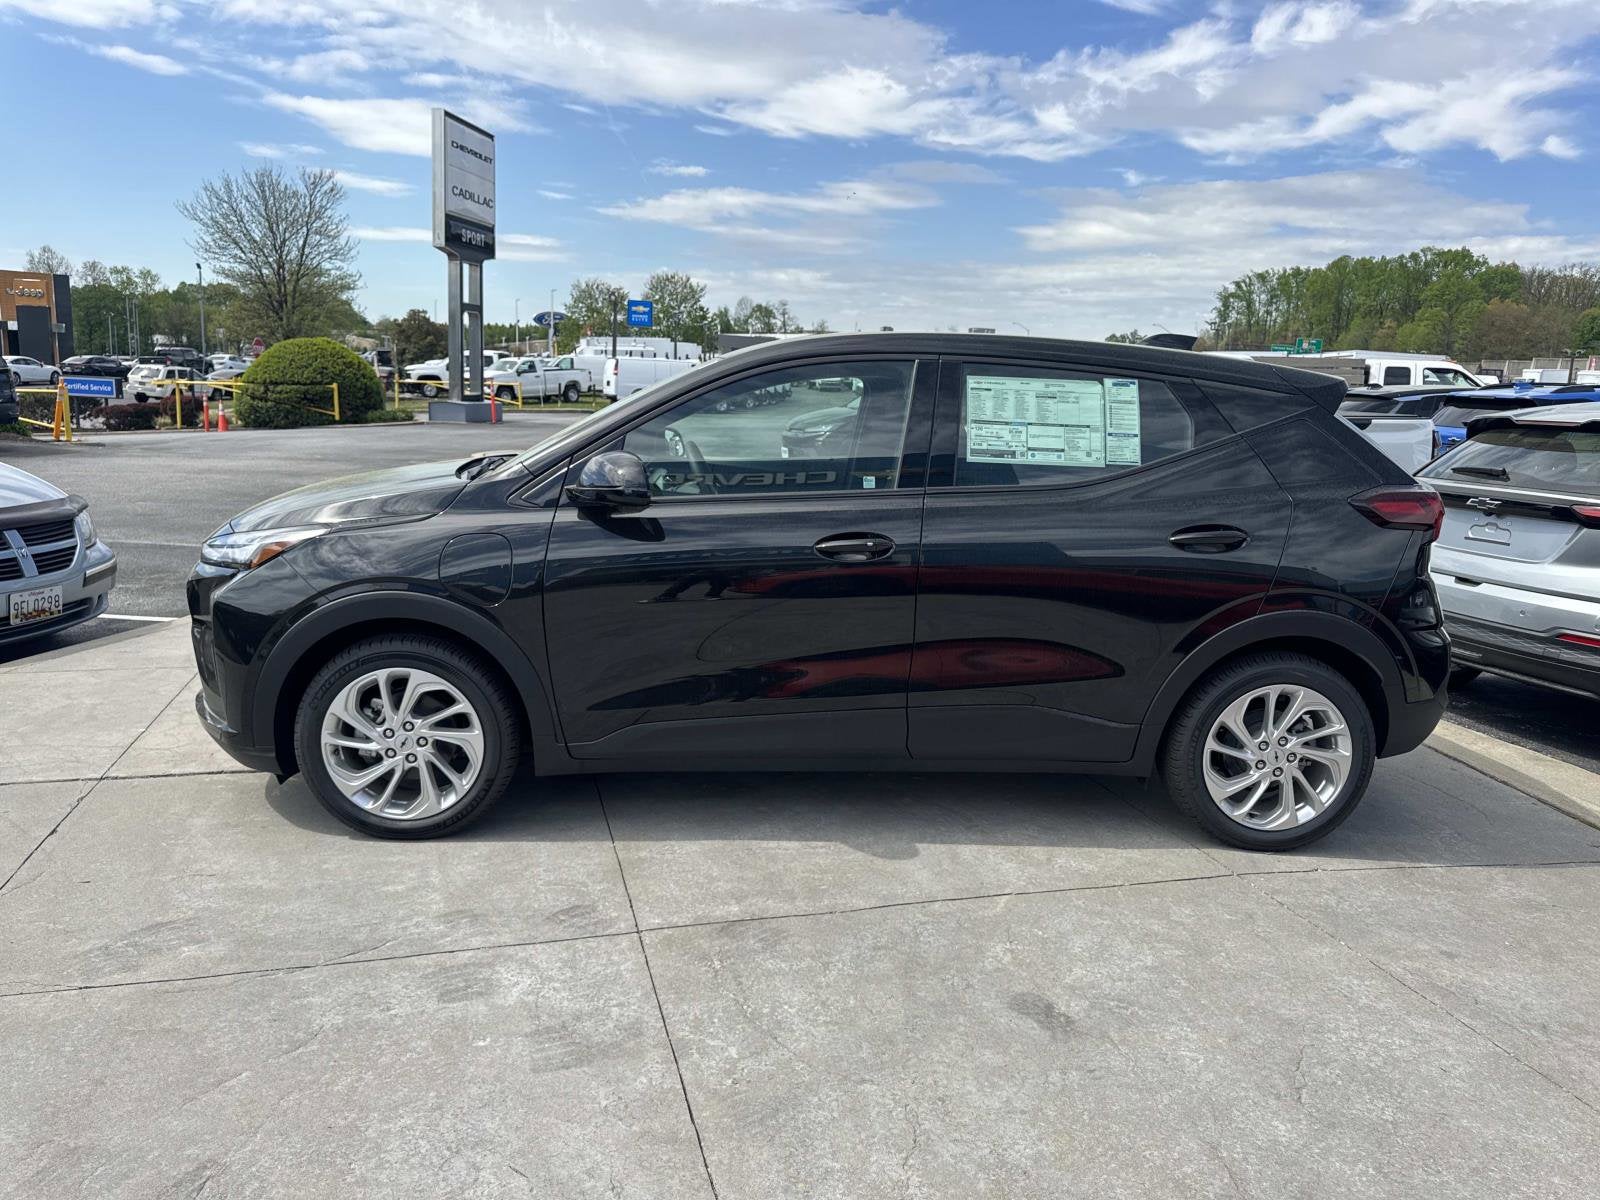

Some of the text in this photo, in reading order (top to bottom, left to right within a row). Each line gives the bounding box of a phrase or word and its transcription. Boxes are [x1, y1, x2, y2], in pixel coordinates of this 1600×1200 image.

[451, 140, 493, 164] CHEVROLET
[451, 185, 494, 208] CADILLAC
[461, 228, 486, 247] SPORT
[15, 285, 44, 299] Jeep
[64, 382, 112, 392] Certified Service
